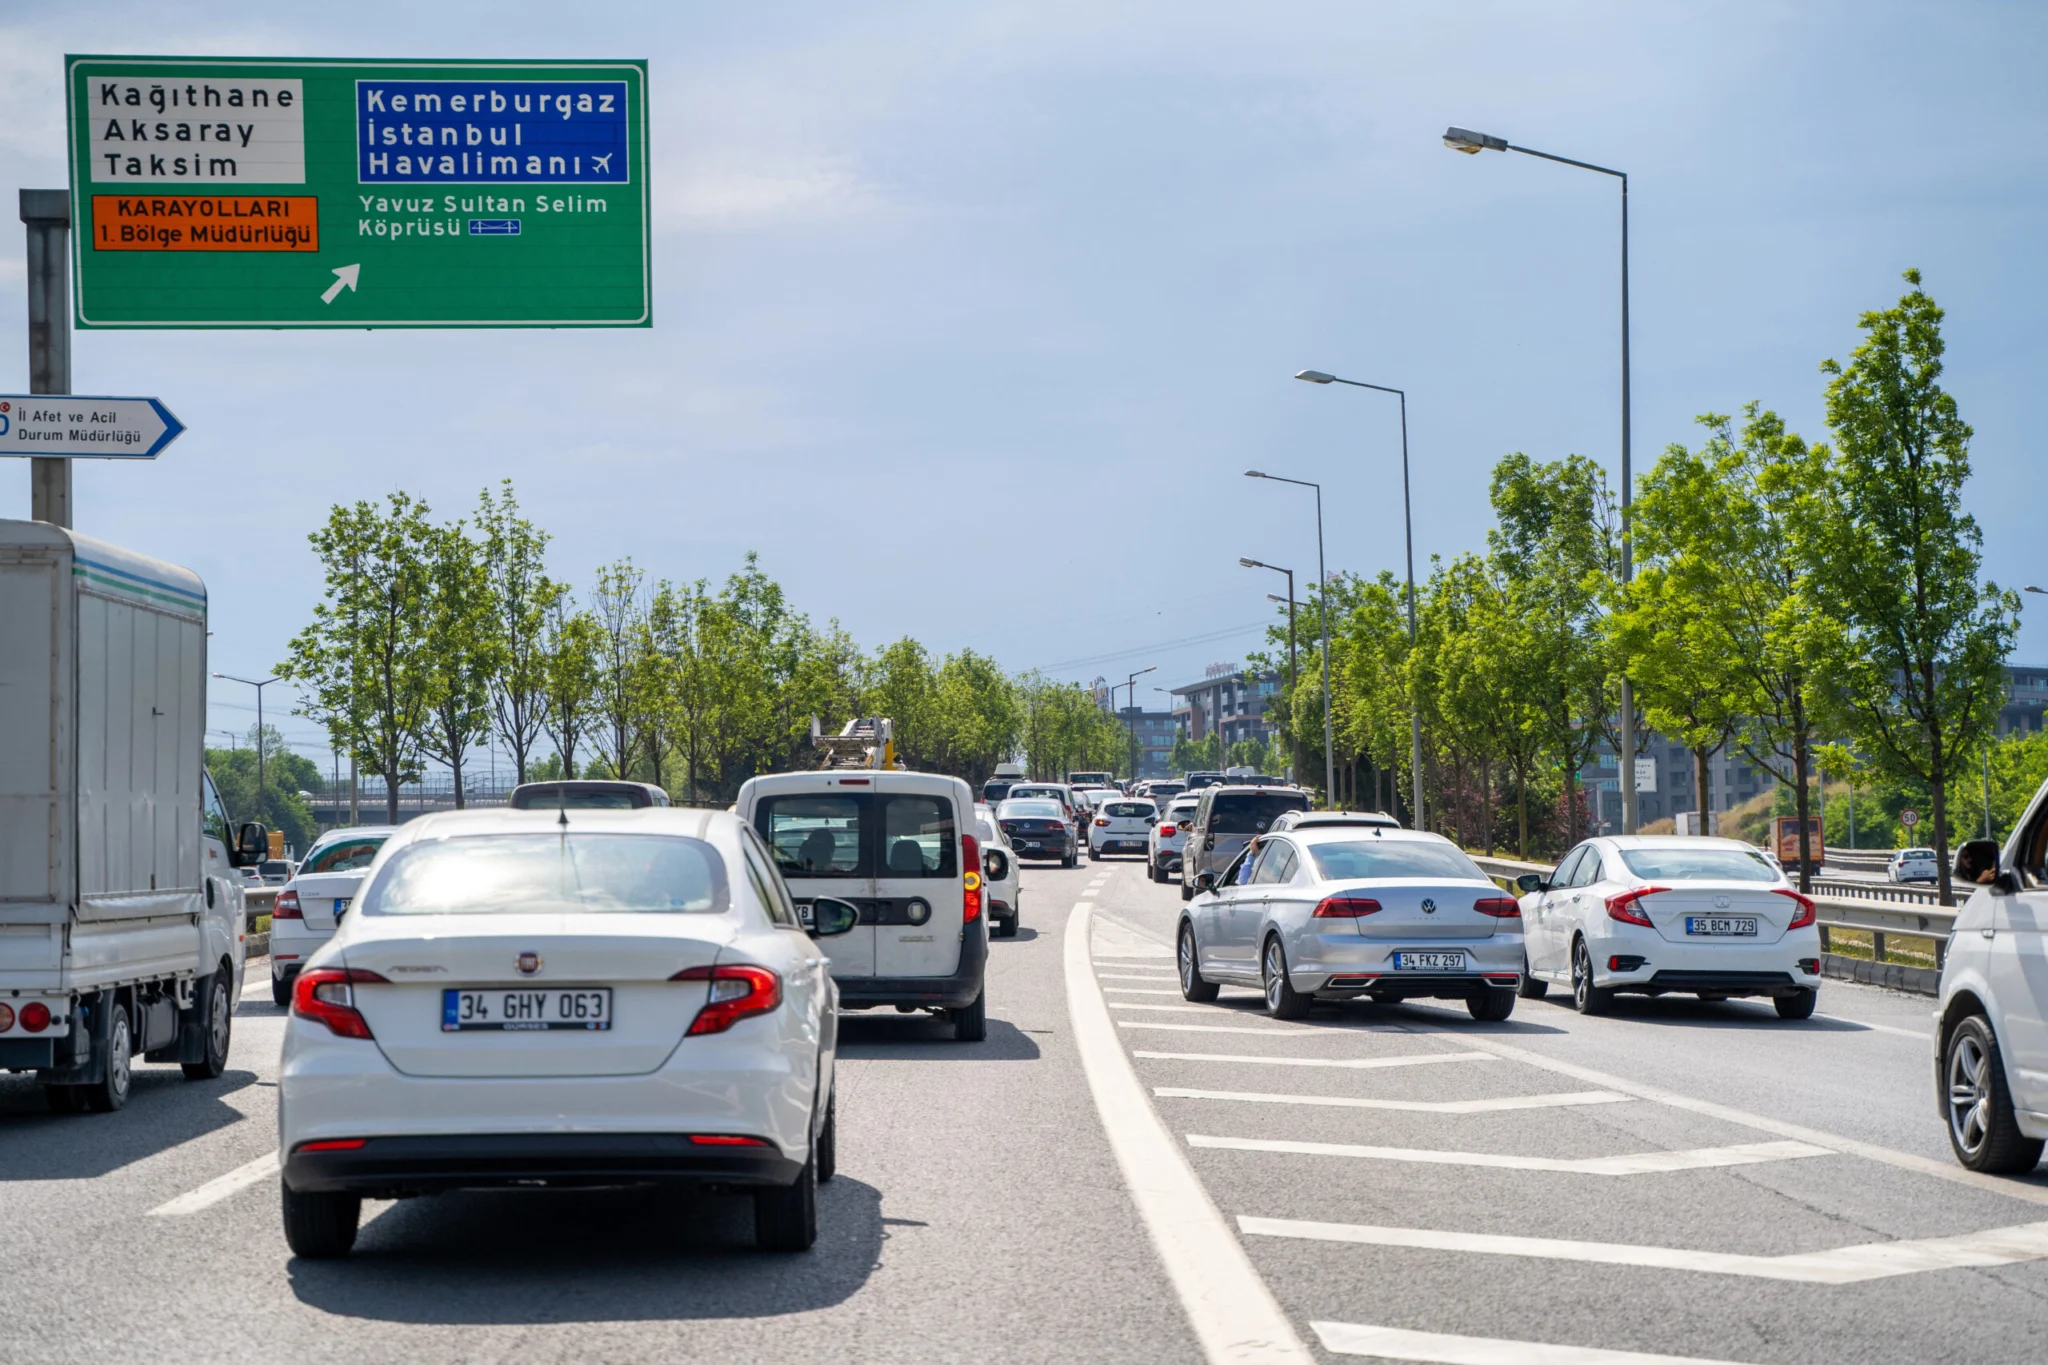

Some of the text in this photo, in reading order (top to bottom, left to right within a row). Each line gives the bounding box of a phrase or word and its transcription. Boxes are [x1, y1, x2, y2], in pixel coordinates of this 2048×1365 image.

[102, 84, 293, 114] Kağıthane
[368, 90, 615, 120] Kemerburgaz
[104, 119, 254, 147] Aksaray
[369, 118, 521, 145] İstanbul
[104, 154, 237, 176] Taksim
[369, 152, 580, 175] Havalimanı
[118, 199, 289, 217] KARAYOLLARI
[359, 195, 607, 213] Yavuz Sultan Selim
[101, 224, 310, 248] 1. Bölge Müdürlüğü
[359, 218, 460, 240] Köprüsü
[18, 406, 117, 424] İl Afet ve Acil
[18, 428, 141, 445] Durum Müdürlüğü
[1904, 814, 1916, 822] 50
[1694, 919, 1754, 932] 35 BCM 729
[1402, 954, 1462, 967] 34 FKZ 297
[460, 993, 603, 1020] 34 GHY 063
